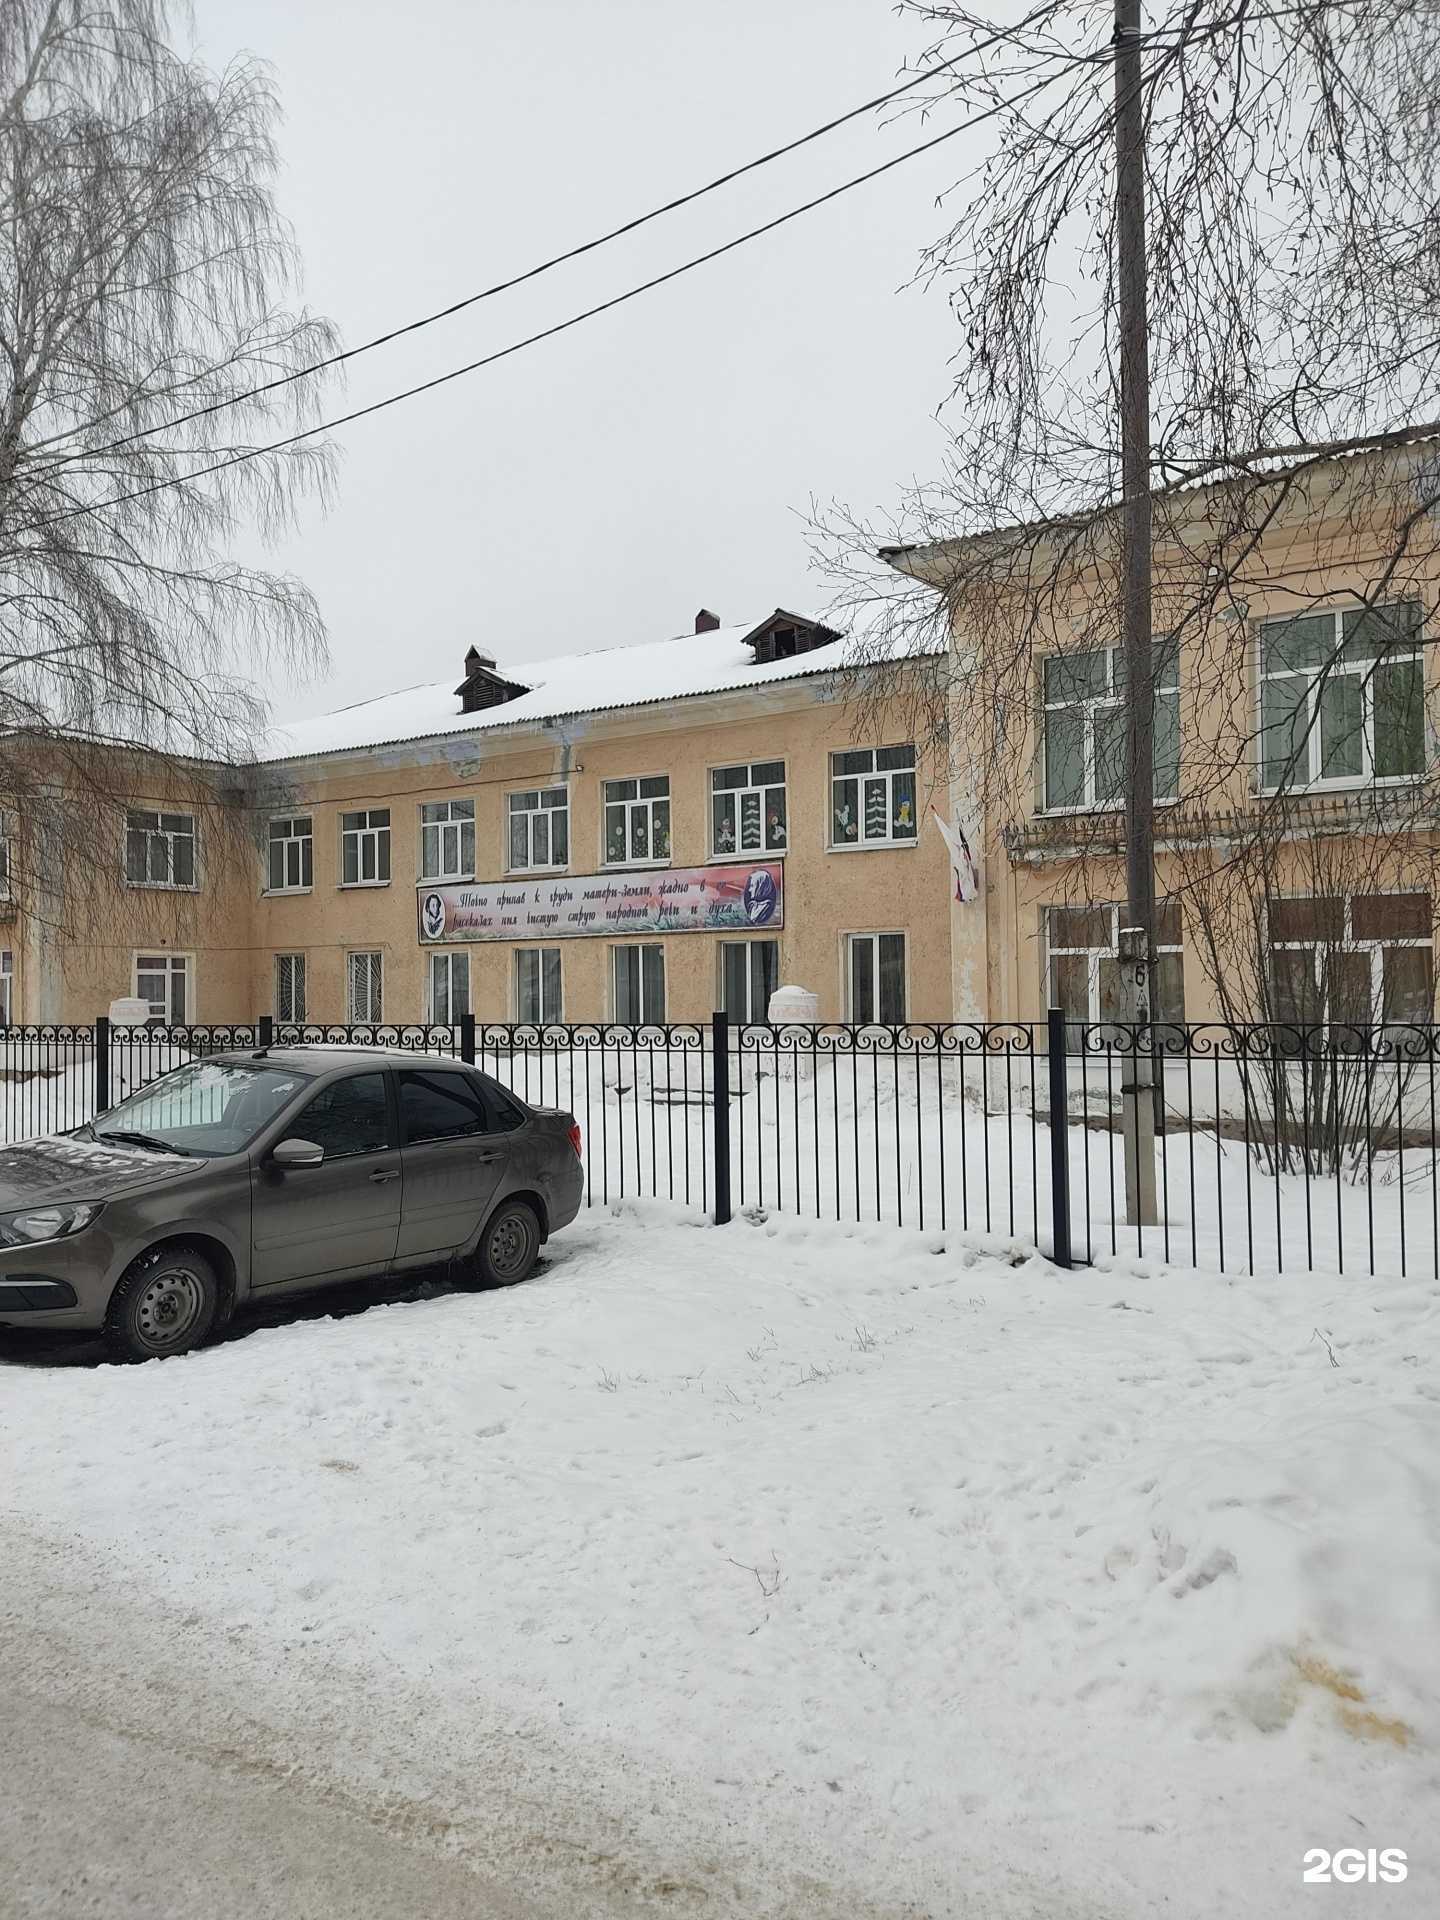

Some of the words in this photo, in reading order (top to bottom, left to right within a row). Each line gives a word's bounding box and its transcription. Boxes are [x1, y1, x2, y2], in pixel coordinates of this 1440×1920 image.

[496, 889, 526, 911] припав
[534, 887, 541, 904] к
[549, 887, 573, 908] груди
[658, 879, 689, 898] жадно
[567, 905, 596, 927] струю
[605, 902, 649, 924] народной
[658, 901, 680, 922] речи
